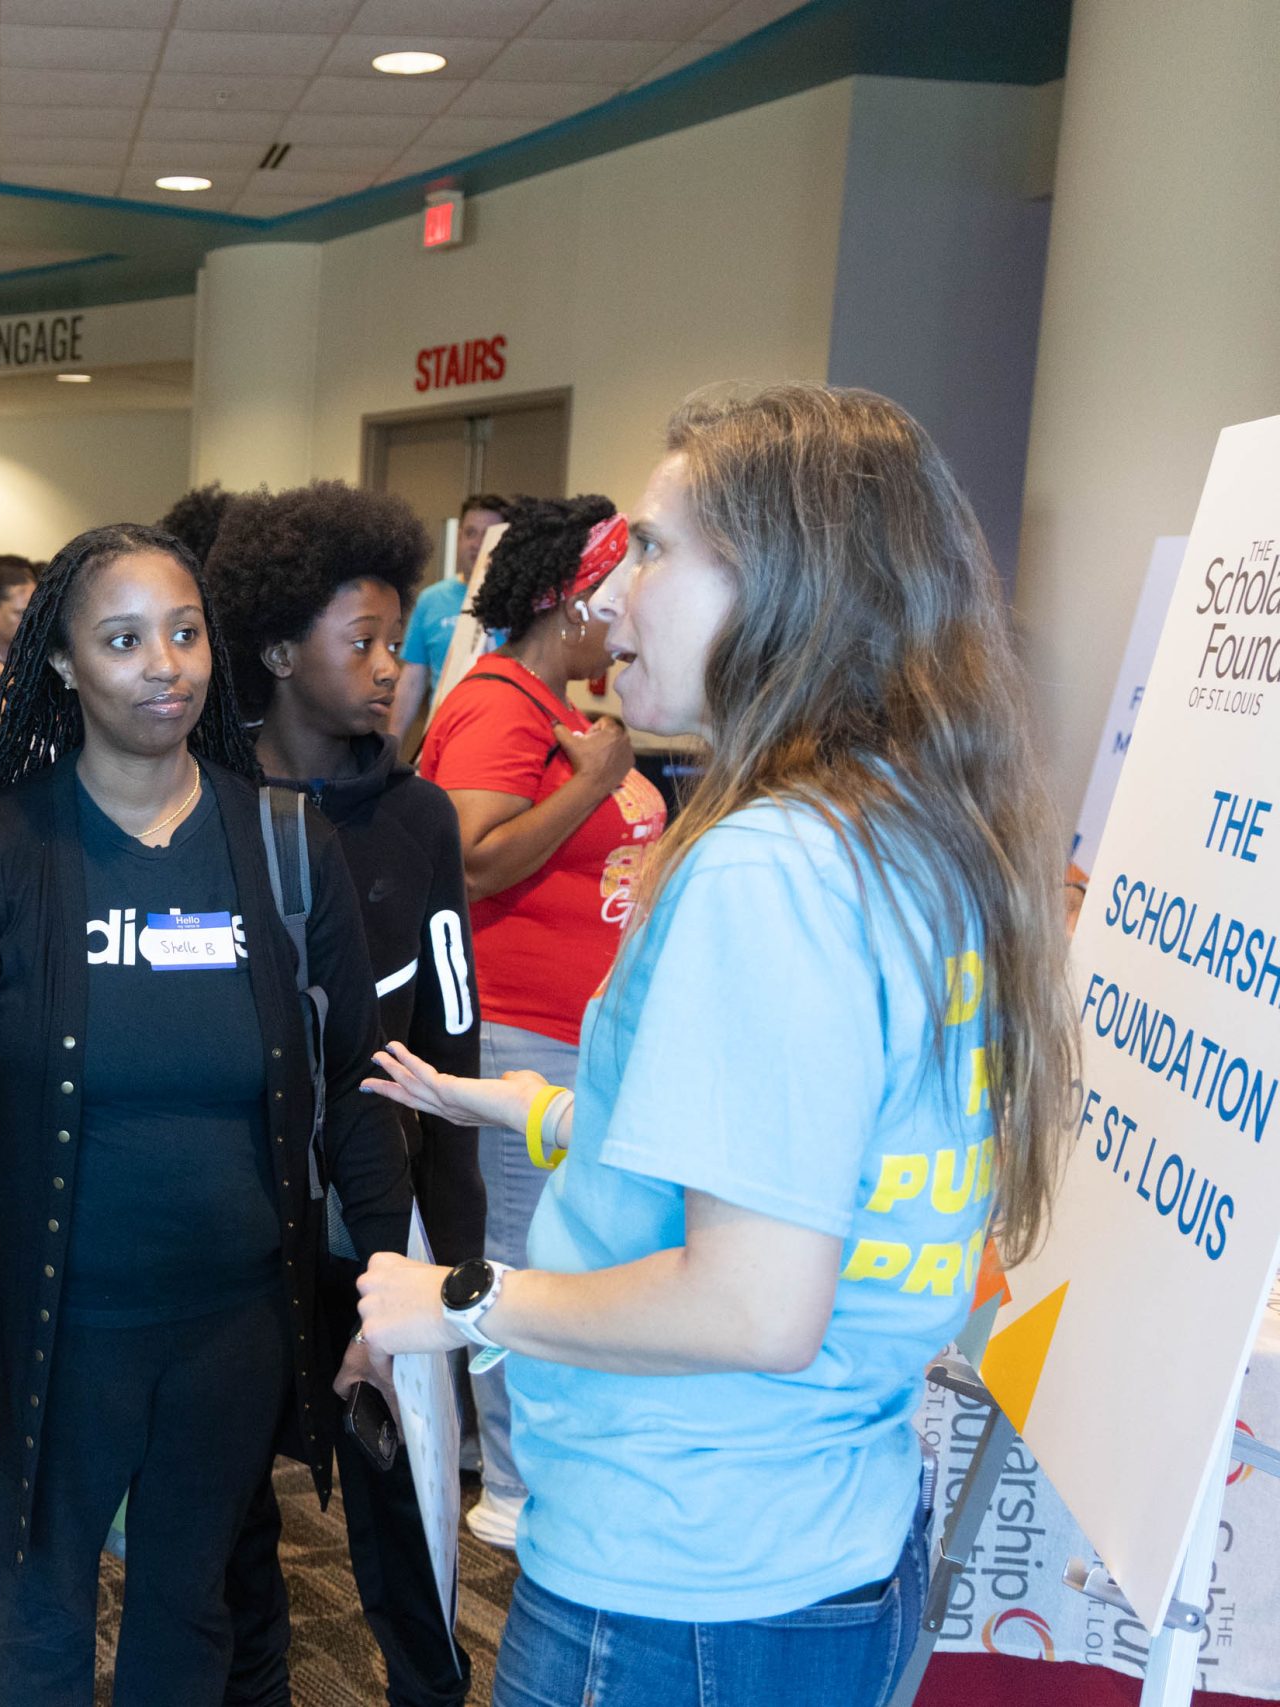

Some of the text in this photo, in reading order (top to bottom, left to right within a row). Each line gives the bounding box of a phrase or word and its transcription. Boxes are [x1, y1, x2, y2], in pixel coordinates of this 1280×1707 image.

[415, 334, 507, 392] STAIRS
[1250, 540, 1275, 562] THE
[1189, 686, 1263, 716] OF ST. LOUIS
[1206, 790, 1272, 863] THE
[176, 916, 200, 925] Hello
[204, 942, 216, 956] B
[1081, 973, 1279, 1143] FOUNDATION
[1096, 1105, 1138, 1183] ST.
[1136, 1137, 1235, 1261] LOUIS
[981, 1435, 1046, 1600] arship
[1216, 1602, 1236, 1647] THE
